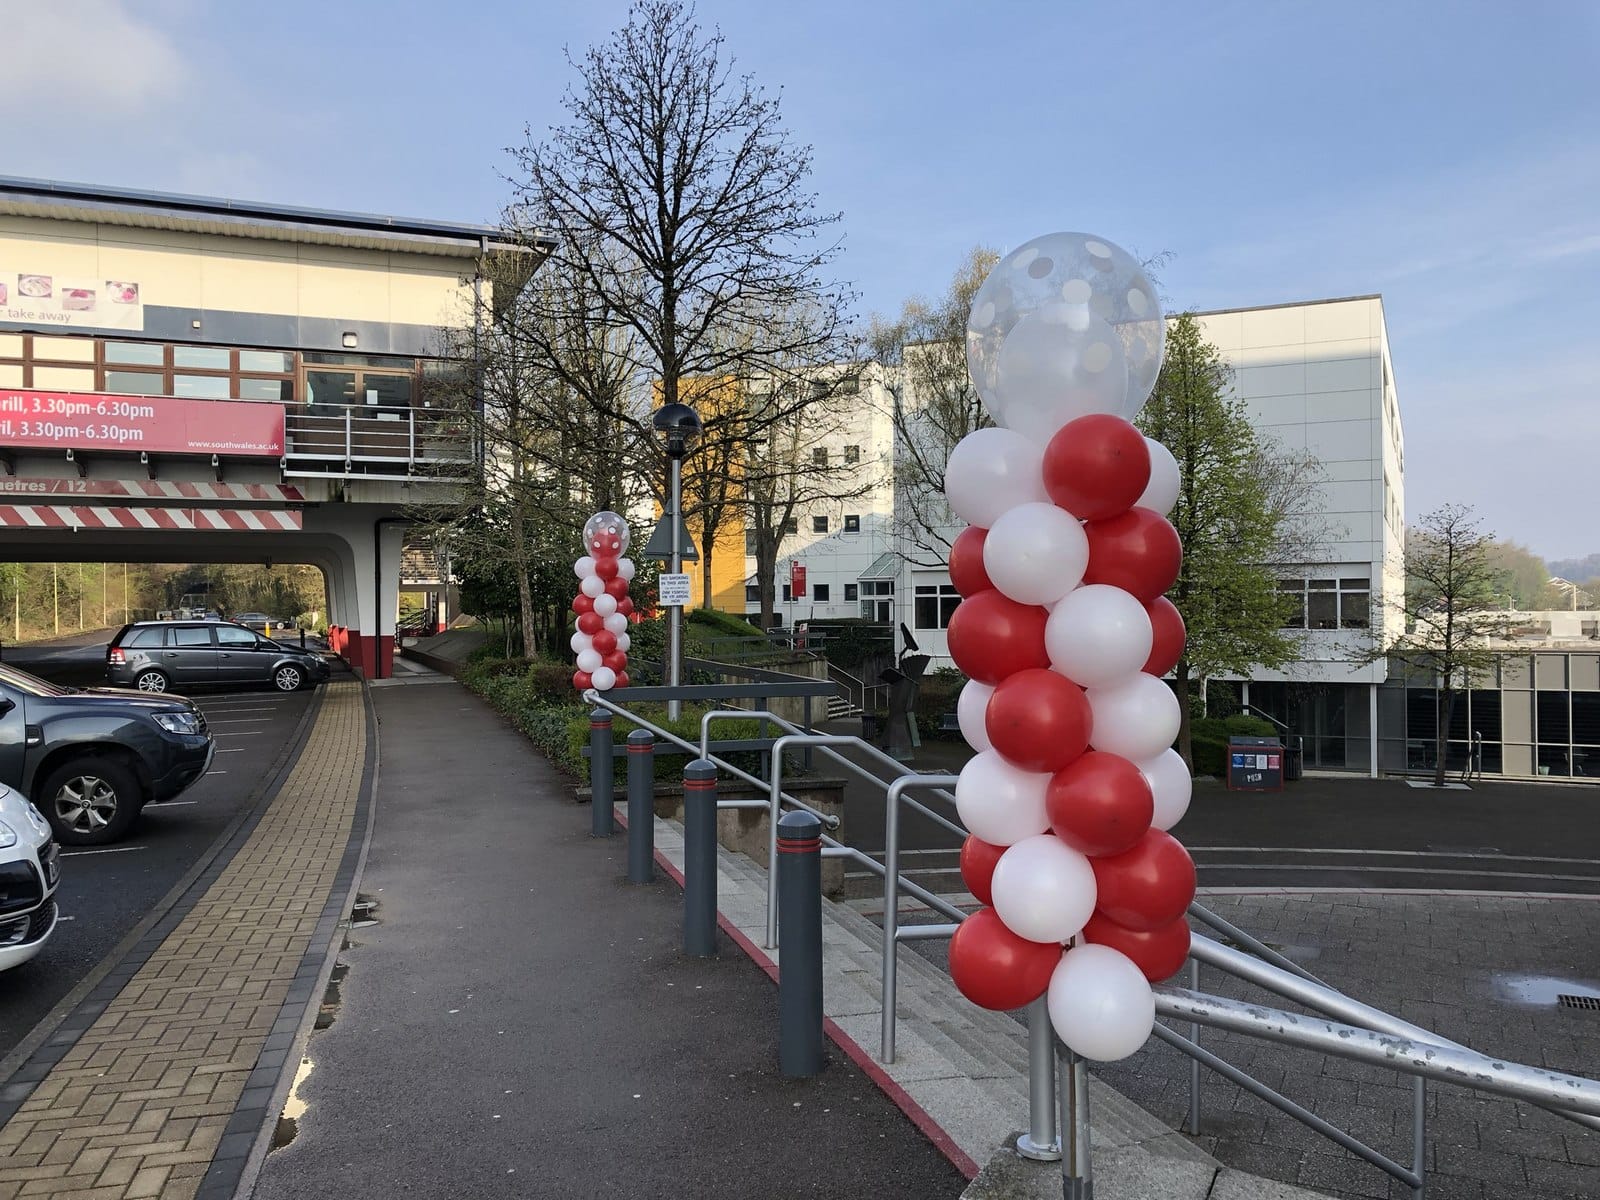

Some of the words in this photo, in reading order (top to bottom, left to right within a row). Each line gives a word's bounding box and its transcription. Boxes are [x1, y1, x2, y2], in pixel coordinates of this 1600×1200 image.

[8, 308, 35, 319] take
[38, 311, 71, 324] away
[0, 396, 28, 415] rill,
[31, 398, 154, 420] 3.30pm-6.30pm
[20, 421, 143, 443] 3.30pm-6.30pm
[187, 440, 279, 450] www.southwales.ac.uk
